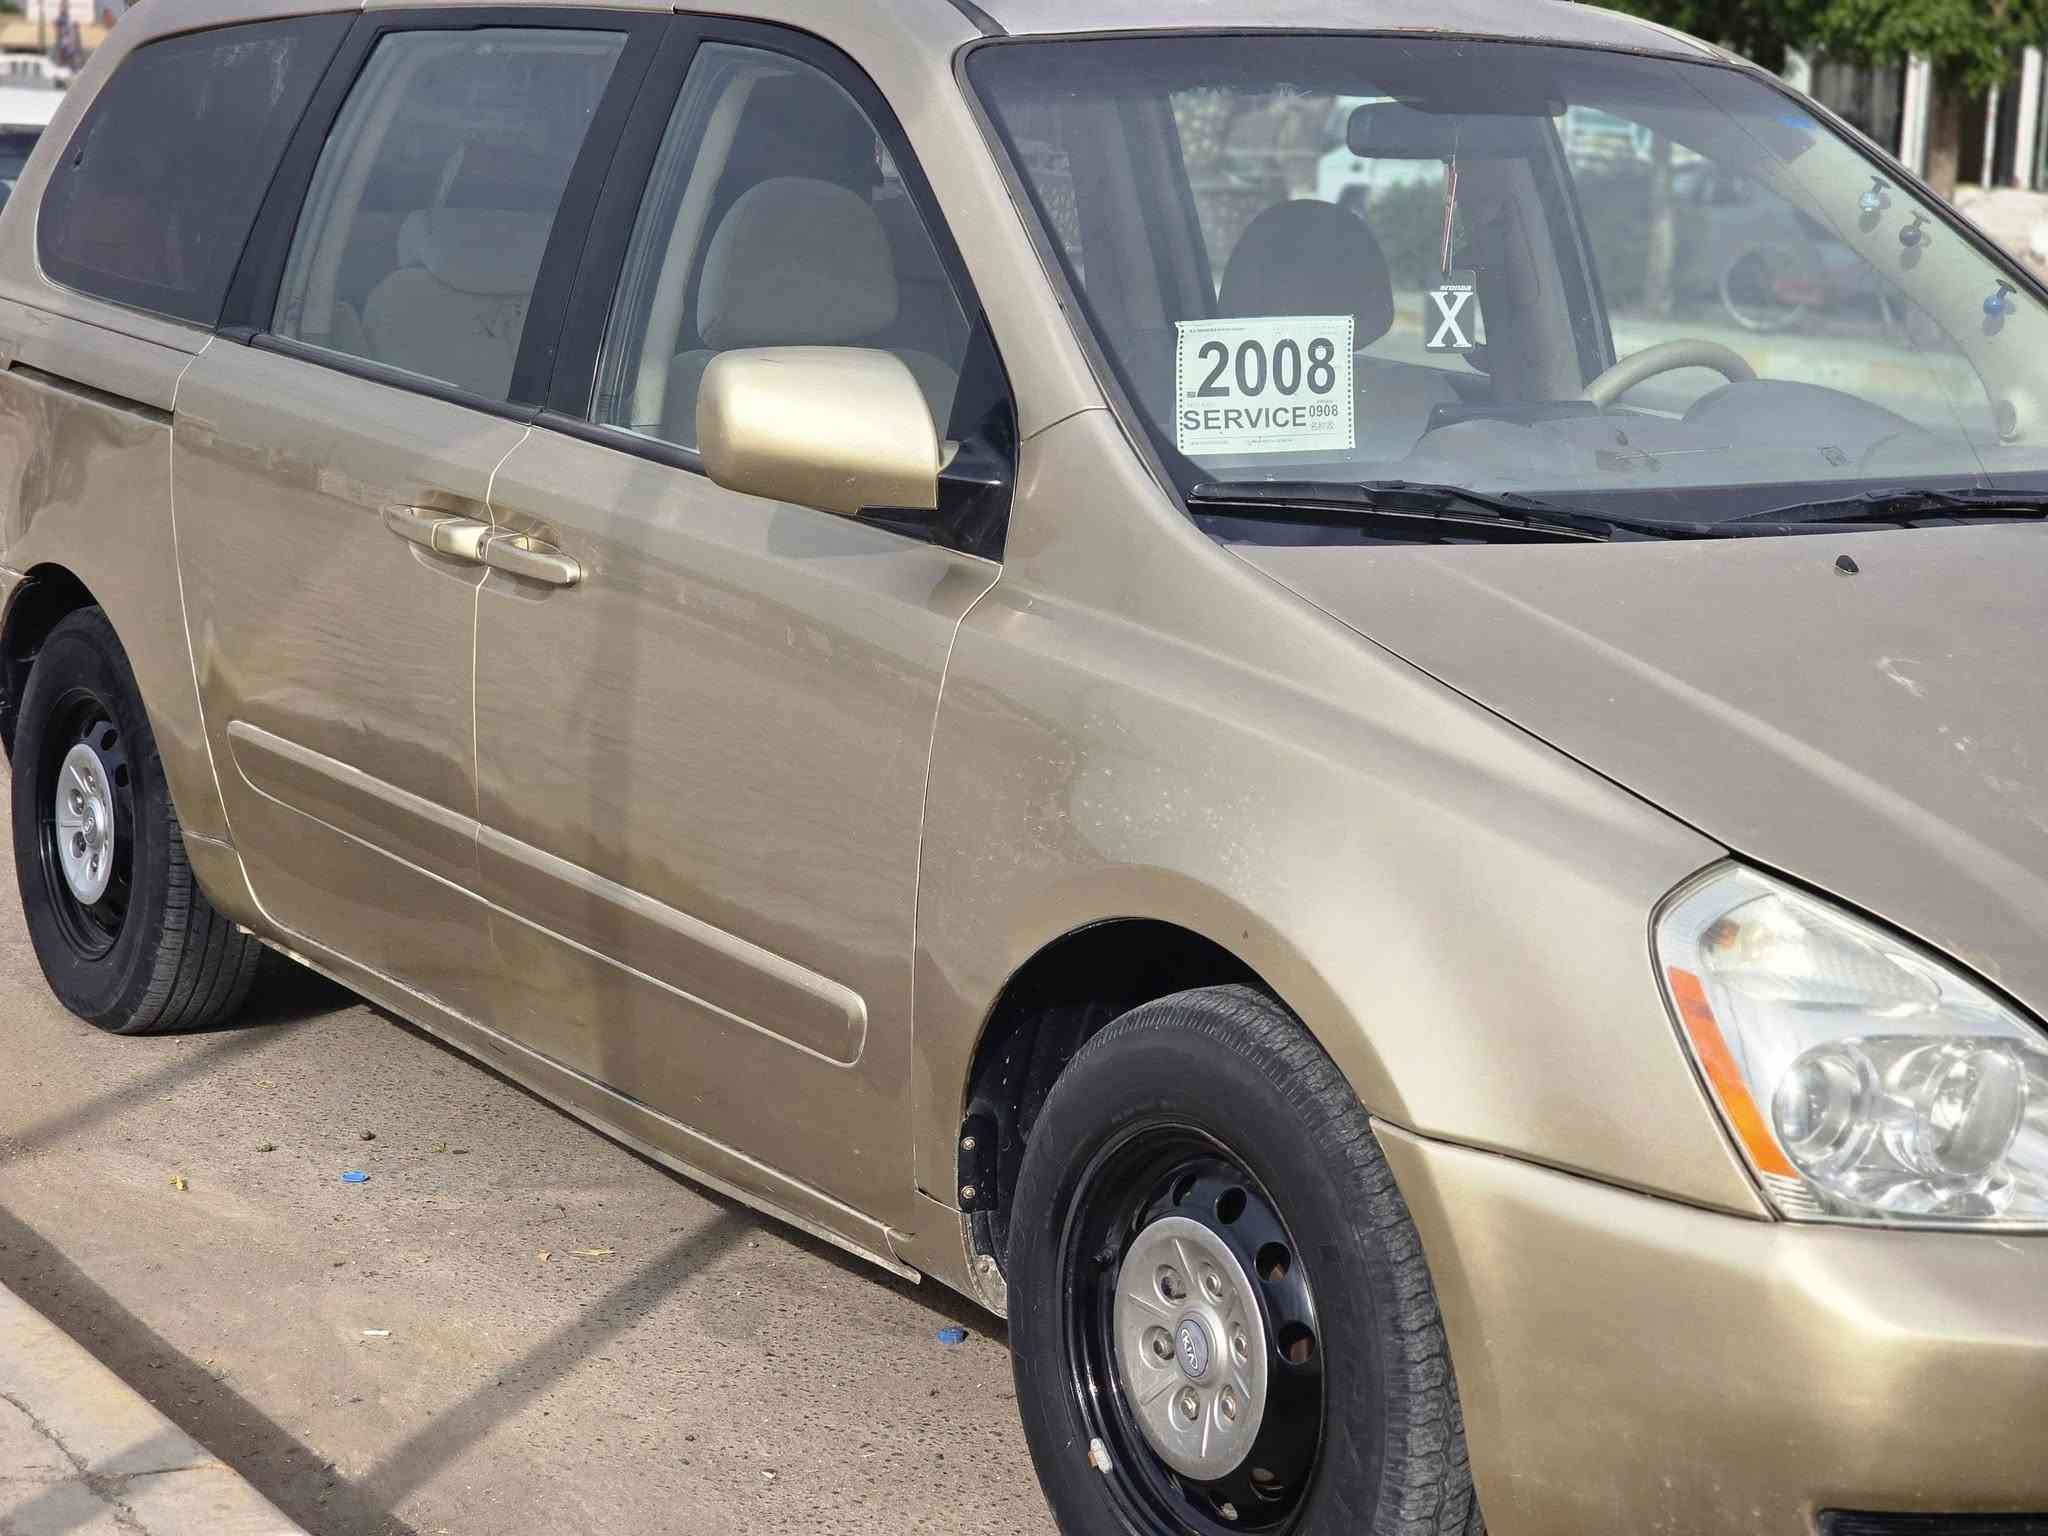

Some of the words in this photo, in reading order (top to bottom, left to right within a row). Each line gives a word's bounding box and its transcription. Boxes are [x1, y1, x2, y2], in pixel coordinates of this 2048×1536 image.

[1427, 292, 1473, 347] X
[1197, 338, 1335, 397] 2008
[1184, 407, 1306, 430] SERVICE
[1309, 405, 1338, 417] 0908
